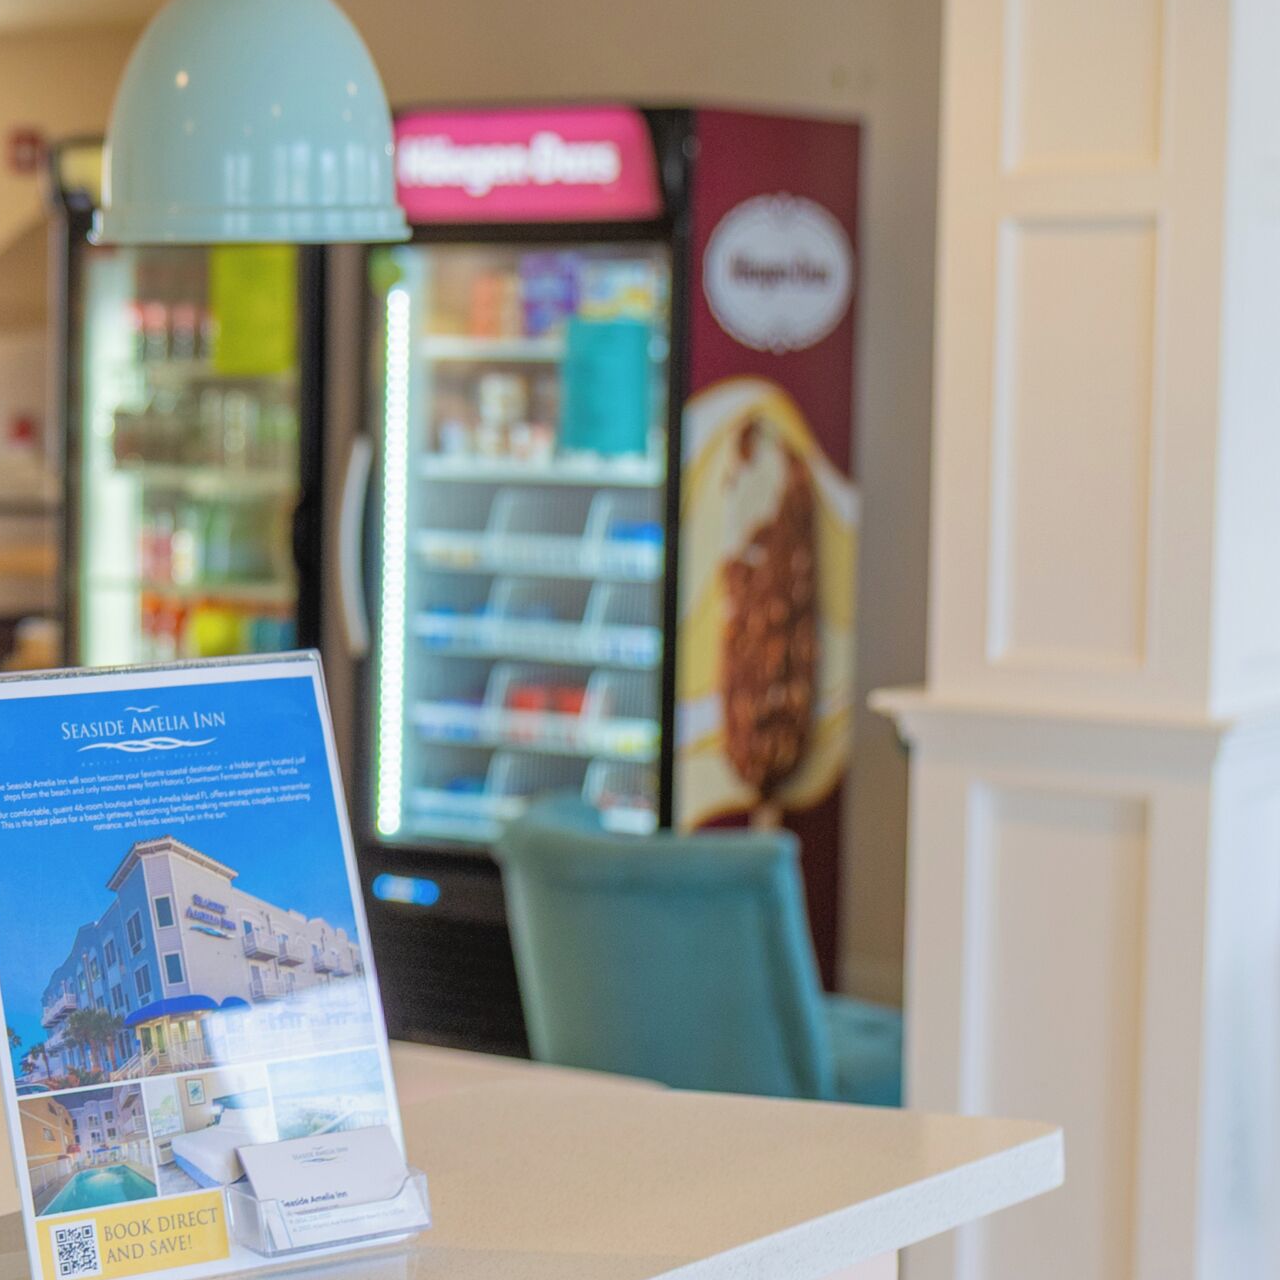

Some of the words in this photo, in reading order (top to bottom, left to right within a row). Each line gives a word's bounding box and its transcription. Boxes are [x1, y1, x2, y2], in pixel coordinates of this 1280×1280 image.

[61, 720, 126, 740] SEASIDE
[130, 715, 190, 734] AMELIA
[193, 711, 226, 729] INN
[104, 1218, 154, 1241] BOOK
[158, 1208, 218, 1232] DIRECT
[106, 1243, 144, 1264] AND
[150, 1234, 192, 1256] SAVE!
